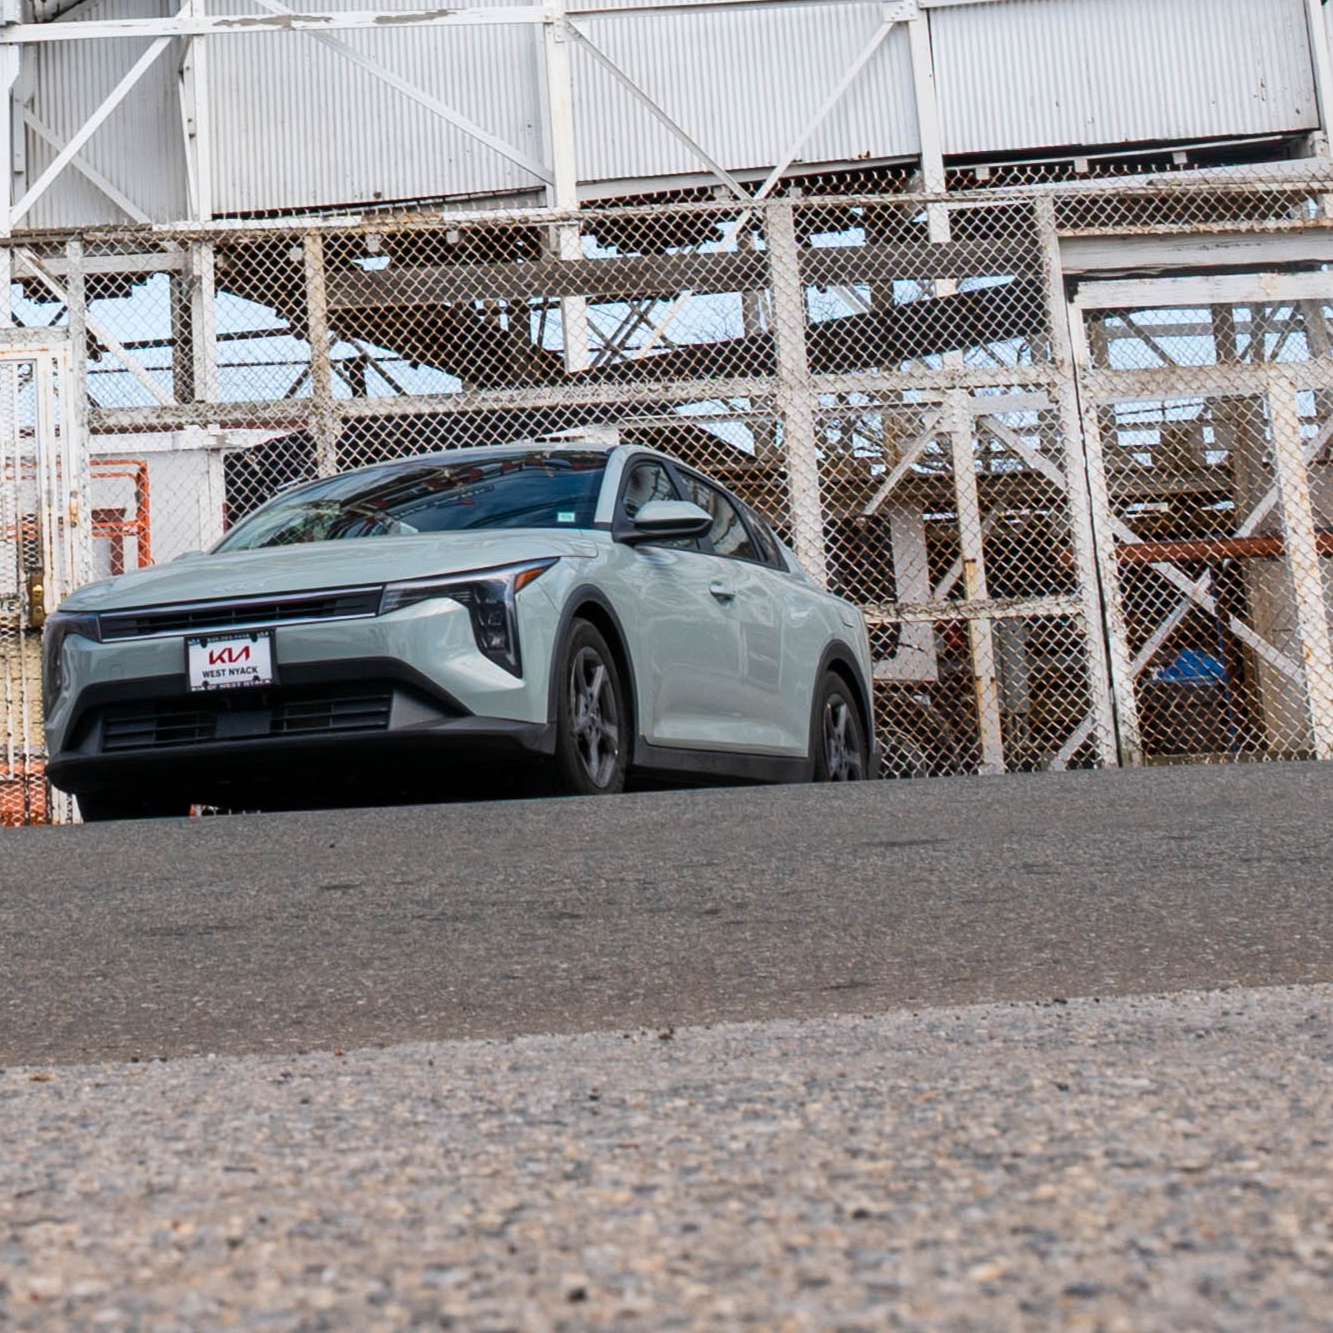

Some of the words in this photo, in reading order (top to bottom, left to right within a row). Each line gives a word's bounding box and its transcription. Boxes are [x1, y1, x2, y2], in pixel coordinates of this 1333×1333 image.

[208, 645, 250, 665] KIA
[201, 668, 226, 678] WEST
[228, 666, 258, 676] NYACK
